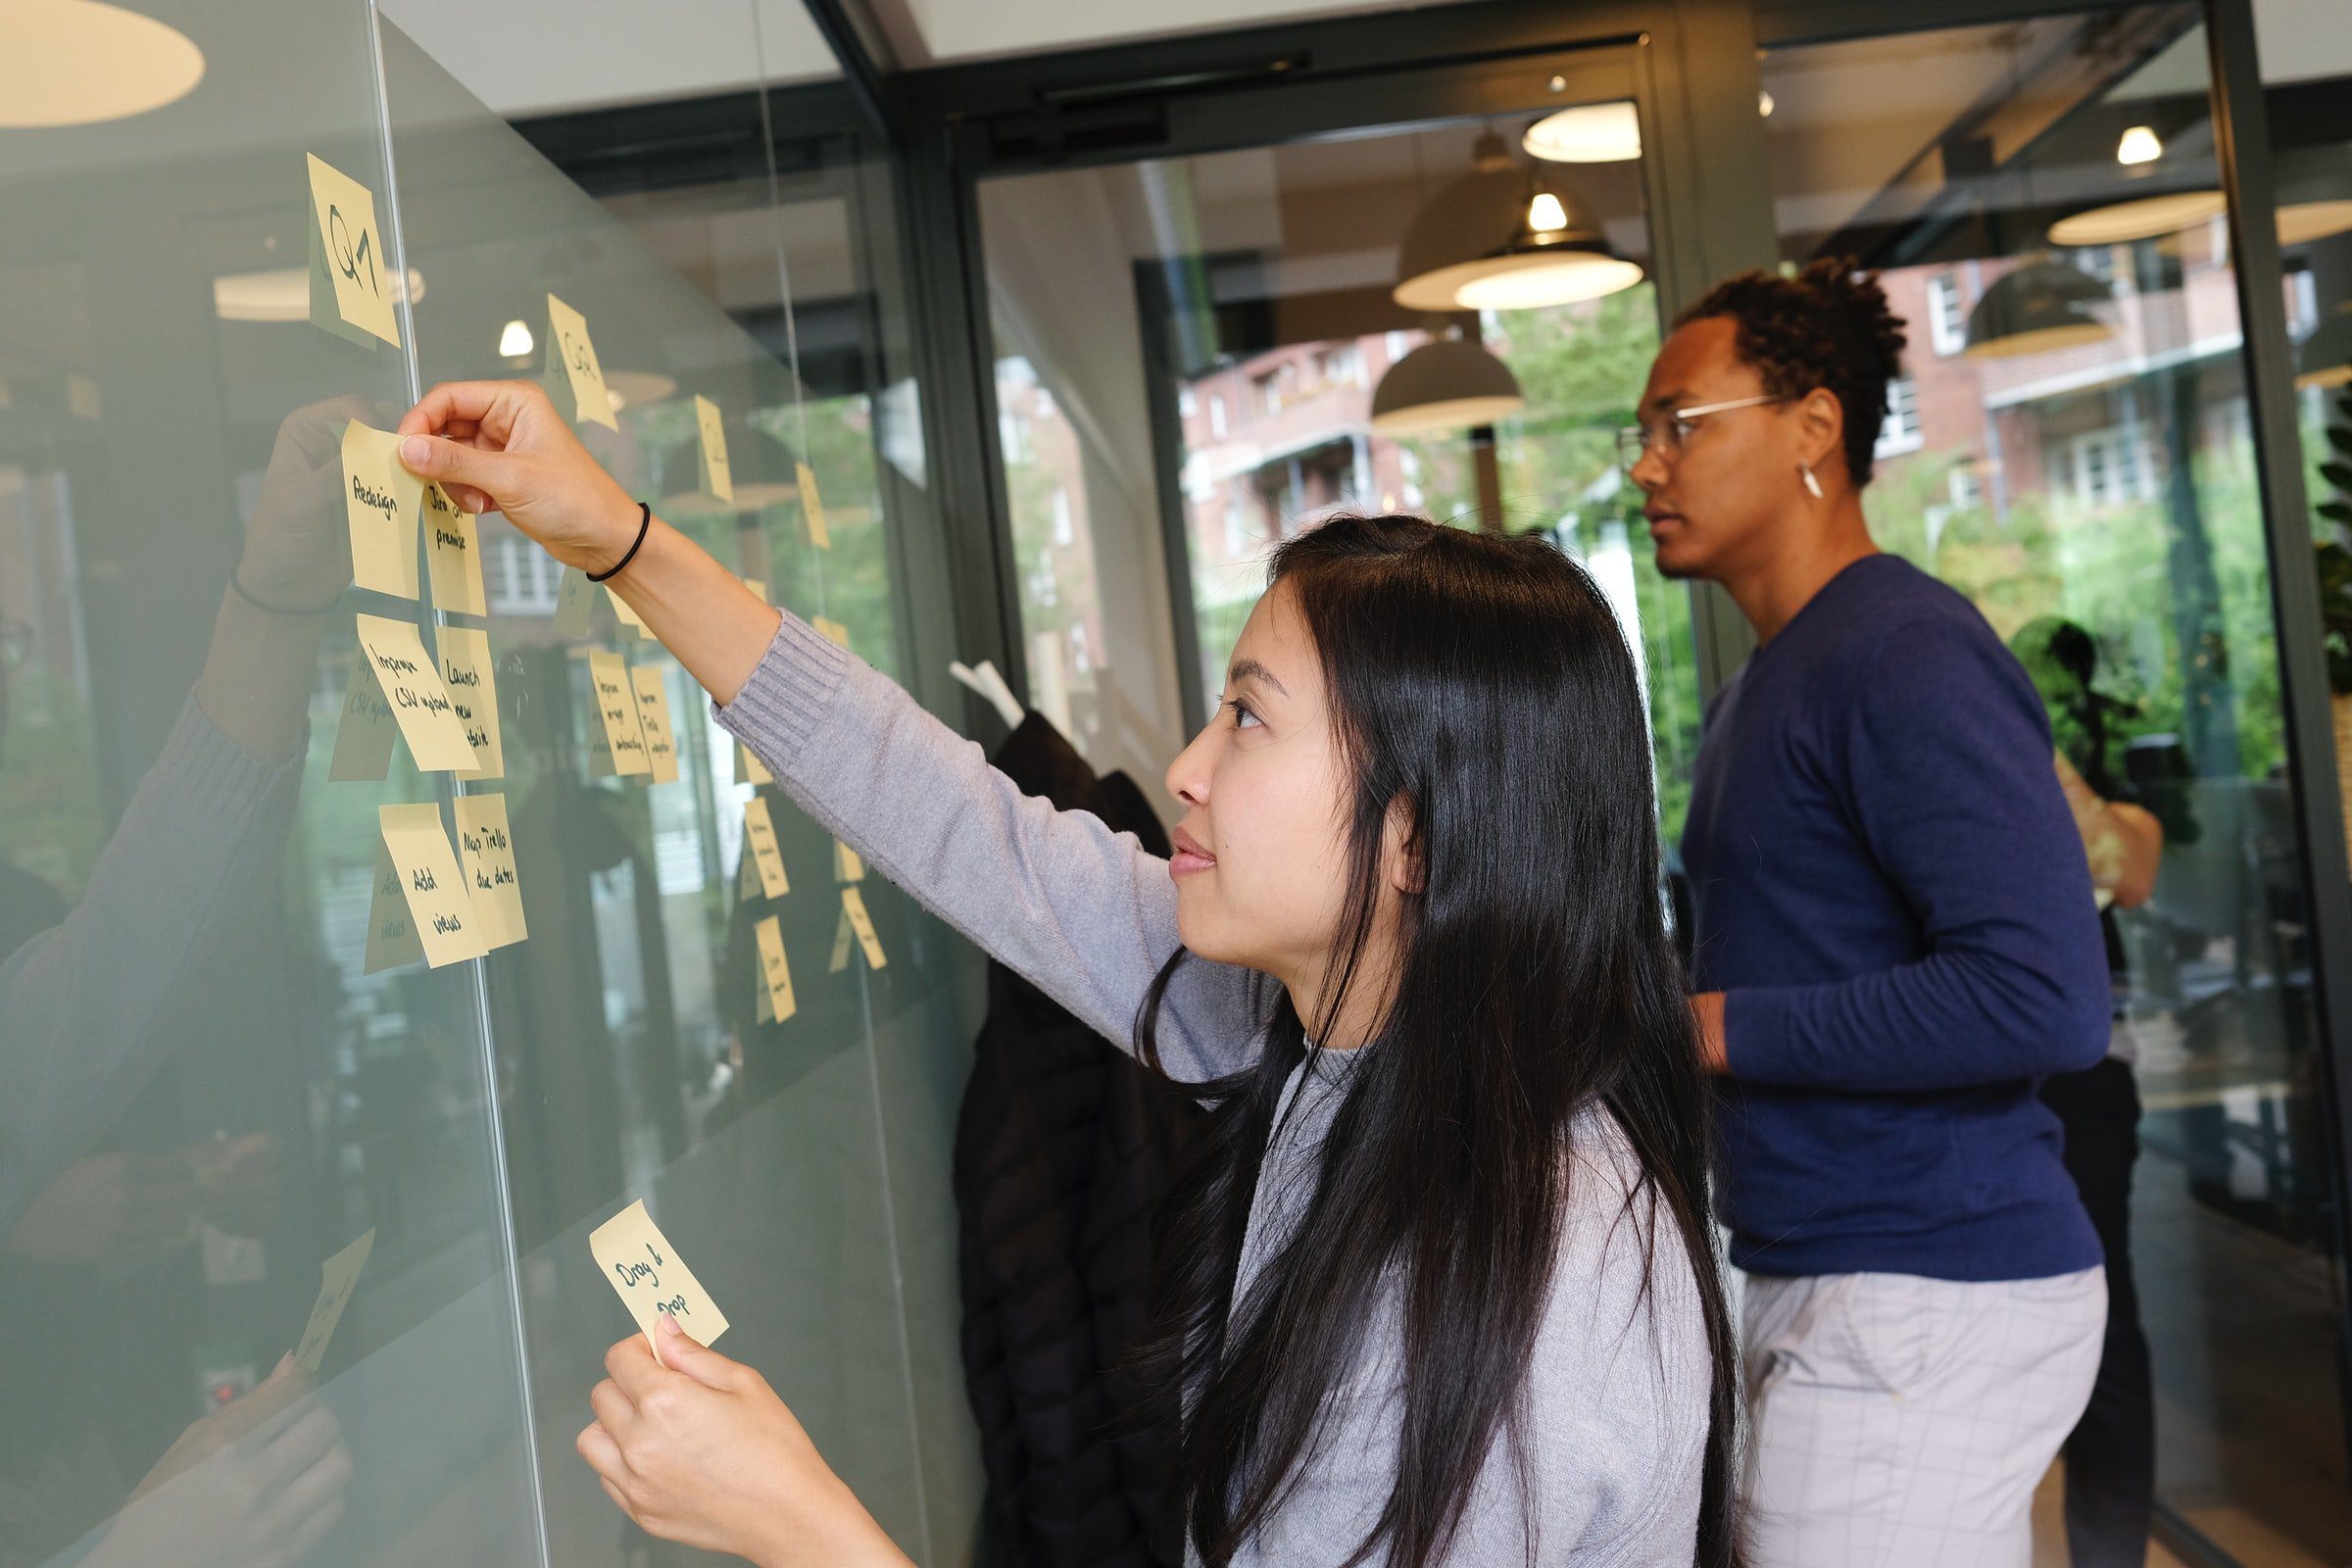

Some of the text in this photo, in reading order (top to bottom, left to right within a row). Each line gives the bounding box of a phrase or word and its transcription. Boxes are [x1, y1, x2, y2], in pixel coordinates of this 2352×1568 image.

[329, 204, 380, 300] Q1
[353, 474, 397, 521] Redesign
[368, 643, 418, 679] Improve
[446, 659, 481, 688] Launch
[394, 687, 418, 709] CSV
[455, 705, 472, 720] new
[466, 725, 489, 749] bsite
[480, 827, 507, 852] Trello
[413, 866, 438, 892] Add
[433, 912, 462, 935] views
[615, 1263, 660, 1288] Drag
